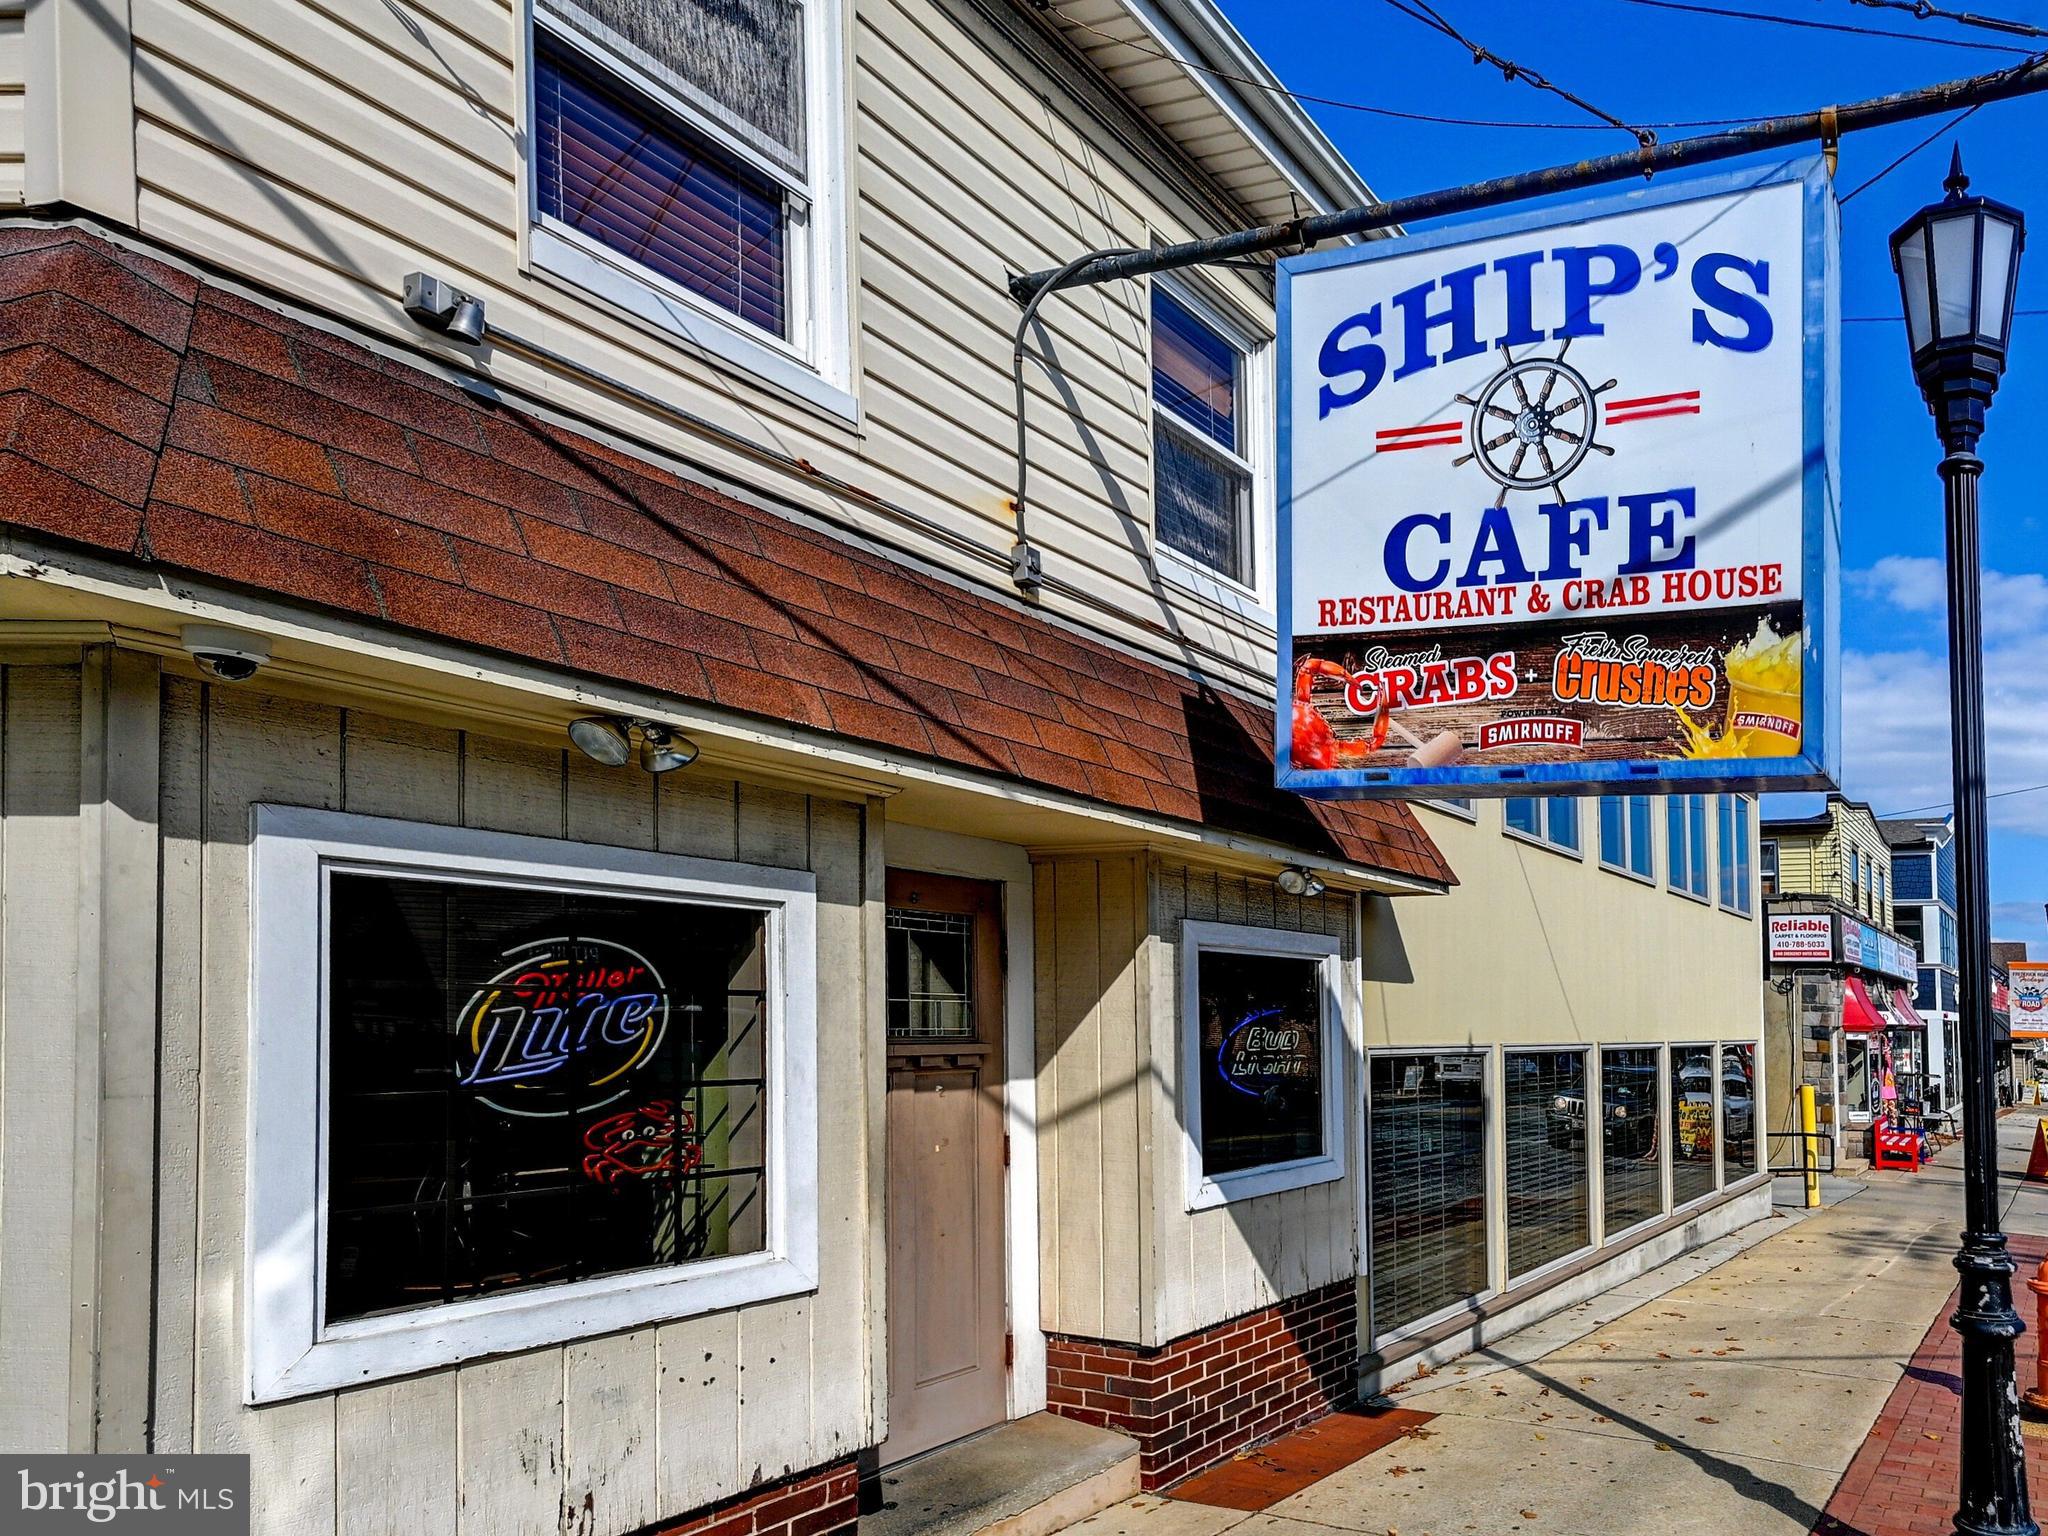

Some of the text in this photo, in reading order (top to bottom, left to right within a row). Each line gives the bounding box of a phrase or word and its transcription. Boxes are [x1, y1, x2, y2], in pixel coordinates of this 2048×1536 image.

[1318, 242, 1774, 420] SHIP'S
[1383, 487, 1697, 593] CAFE
[1318, 563, 1783, 627] RESTAURANT & CRAB HOUSE
[1365, 644, 1441, 672] Steamed
[1562, 632, 1715, 672] Fresh Squeezed
[1346, 653, 1516, 713] CRABS
[1555, 651, 1715, 708] Crushes
[1500, 707, 1563, 718] POWERED BY
[1737, 715, 1794, 734] SMIRNOFF
[1771, 919, 1829, 932] Reliable
[2022, 1000, 2040, 1008] ROAD
[1246, 1027, 1299, 1051] BUD
